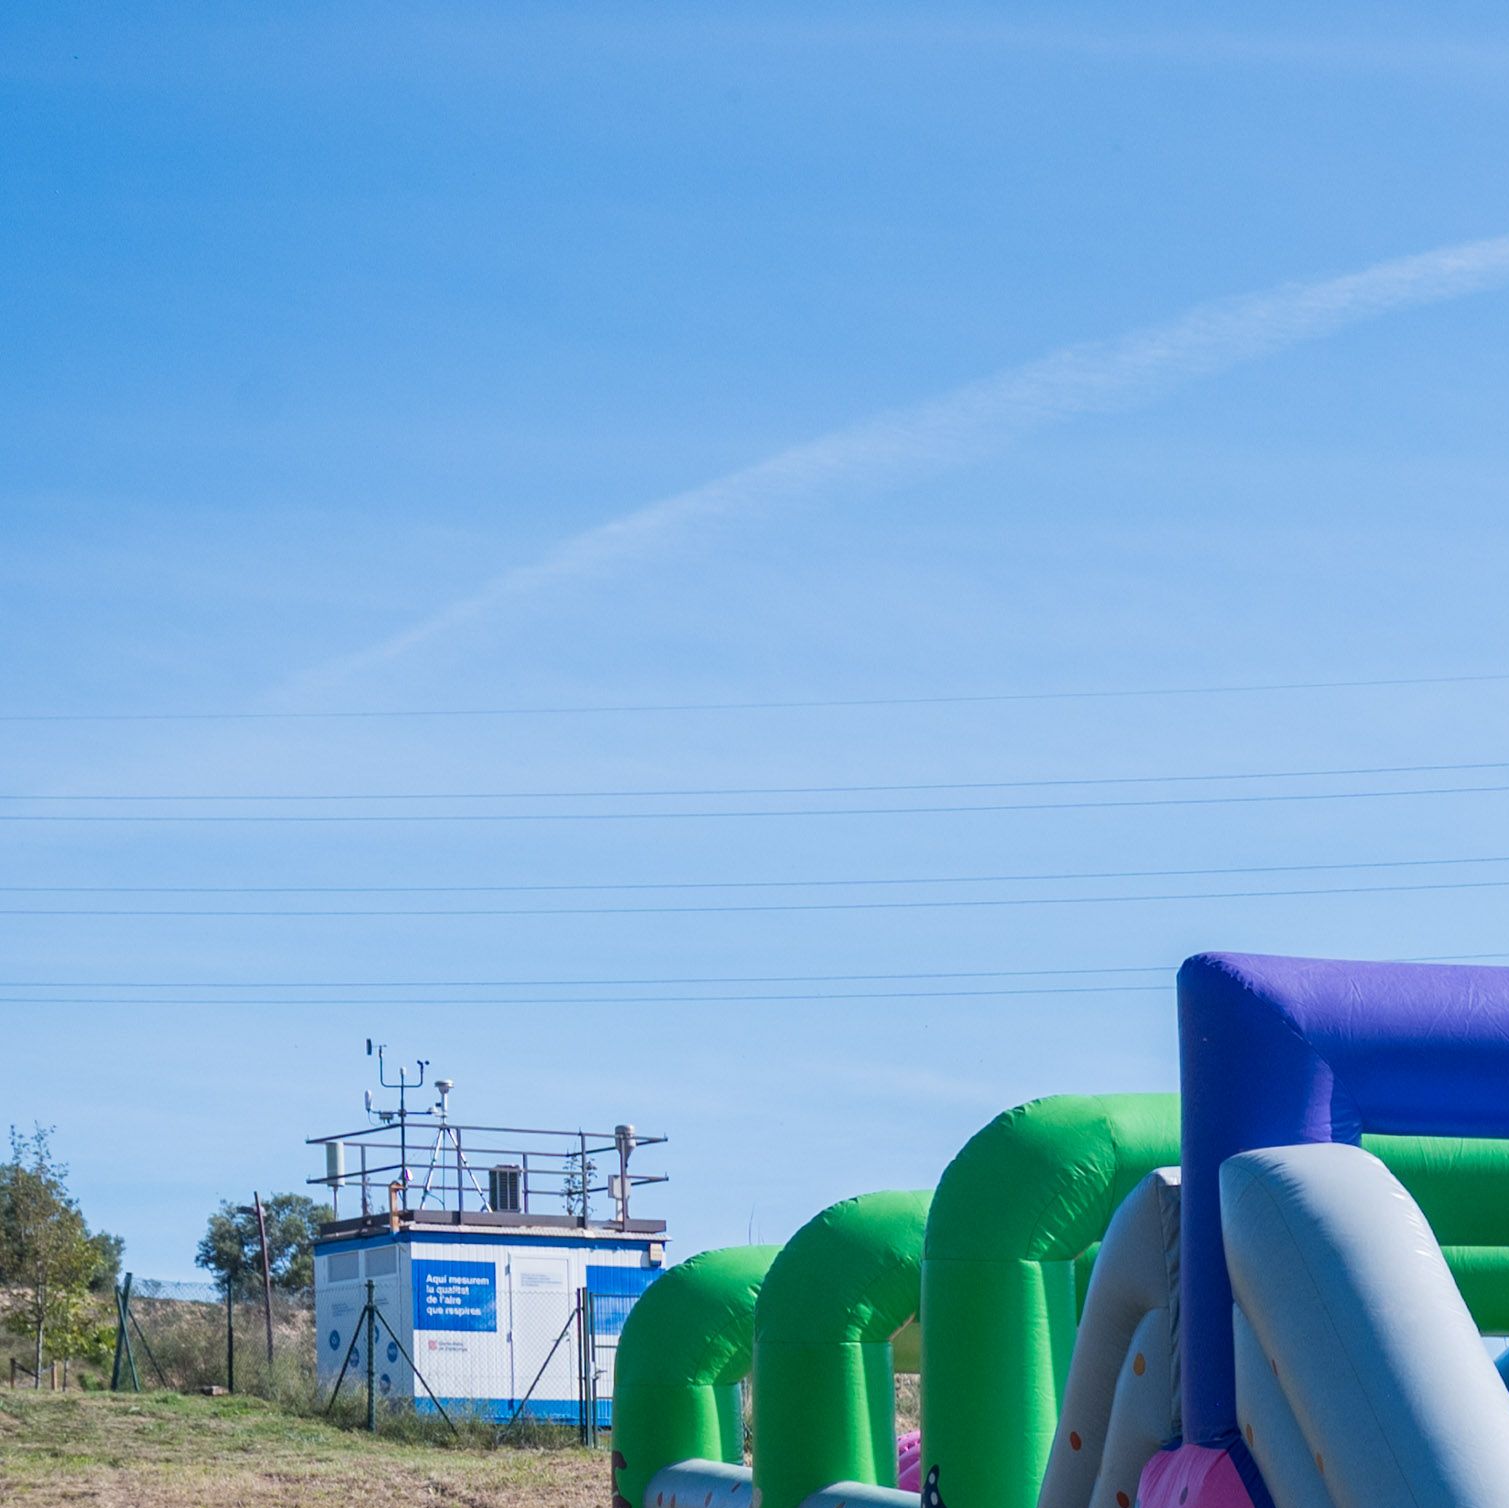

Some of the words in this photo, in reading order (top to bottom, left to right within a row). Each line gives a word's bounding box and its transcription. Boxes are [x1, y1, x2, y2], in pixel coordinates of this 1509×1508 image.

[448, 1276, 489, 1285] mesurem
[426, 1285, 434, 1293] la
[436, 1286, 469, 1295] qualitat
[426, 1295, 438, 1304] de
[426, 1307, 444, 1316] que
